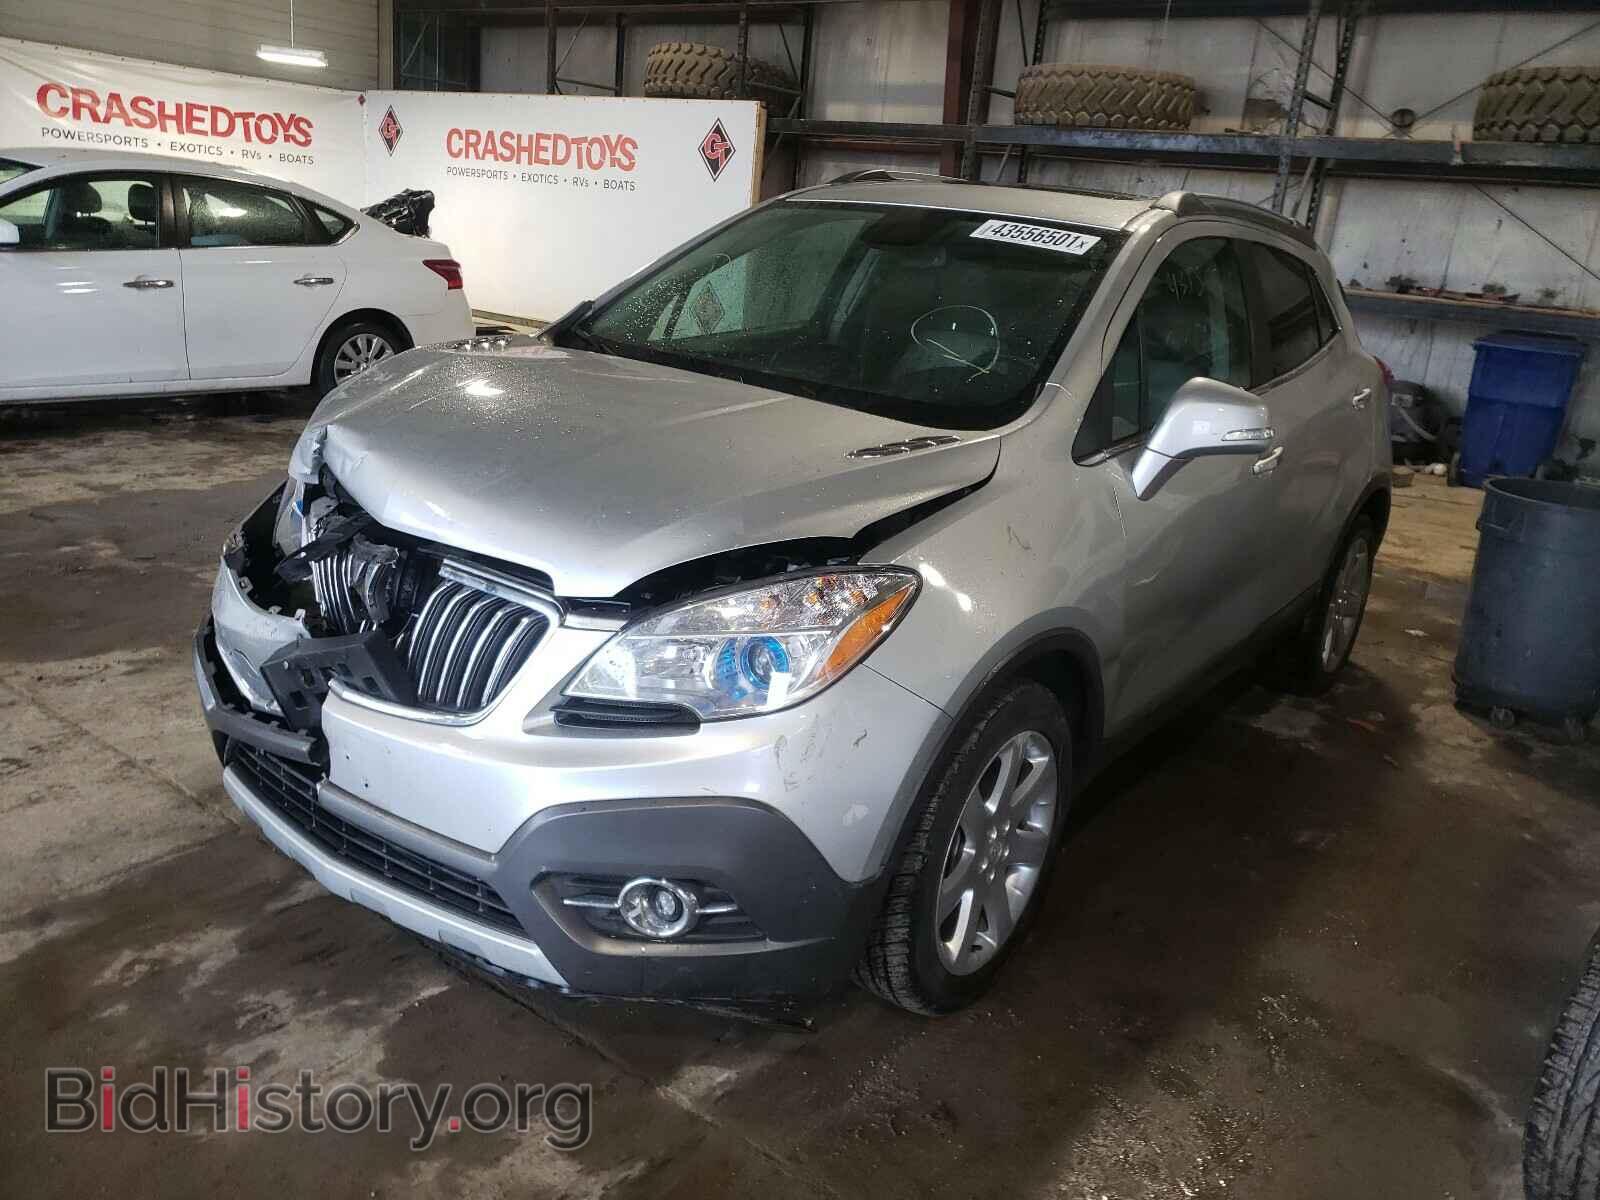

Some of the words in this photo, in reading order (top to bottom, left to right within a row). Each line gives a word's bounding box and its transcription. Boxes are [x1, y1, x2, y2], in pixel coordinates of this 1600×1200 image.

[36, 82, 314, 148] CRASHEDTOYS
[41, 127, 149, 149] POWERSPORTS
[169, 141, 223, 156] EXOTICS
[241, 149, 262, 161] RVs
[279, 153, 314, 165] BOATS
[446, 127, 639, 172] CRASHEDTOYS
[446, 166, 509, 181] POWERSPORTS
[521, 172, 559, 185] EXOTICS
[572, 177, 589, 188] RVs
[603, 179, 636, 192] BOATS
